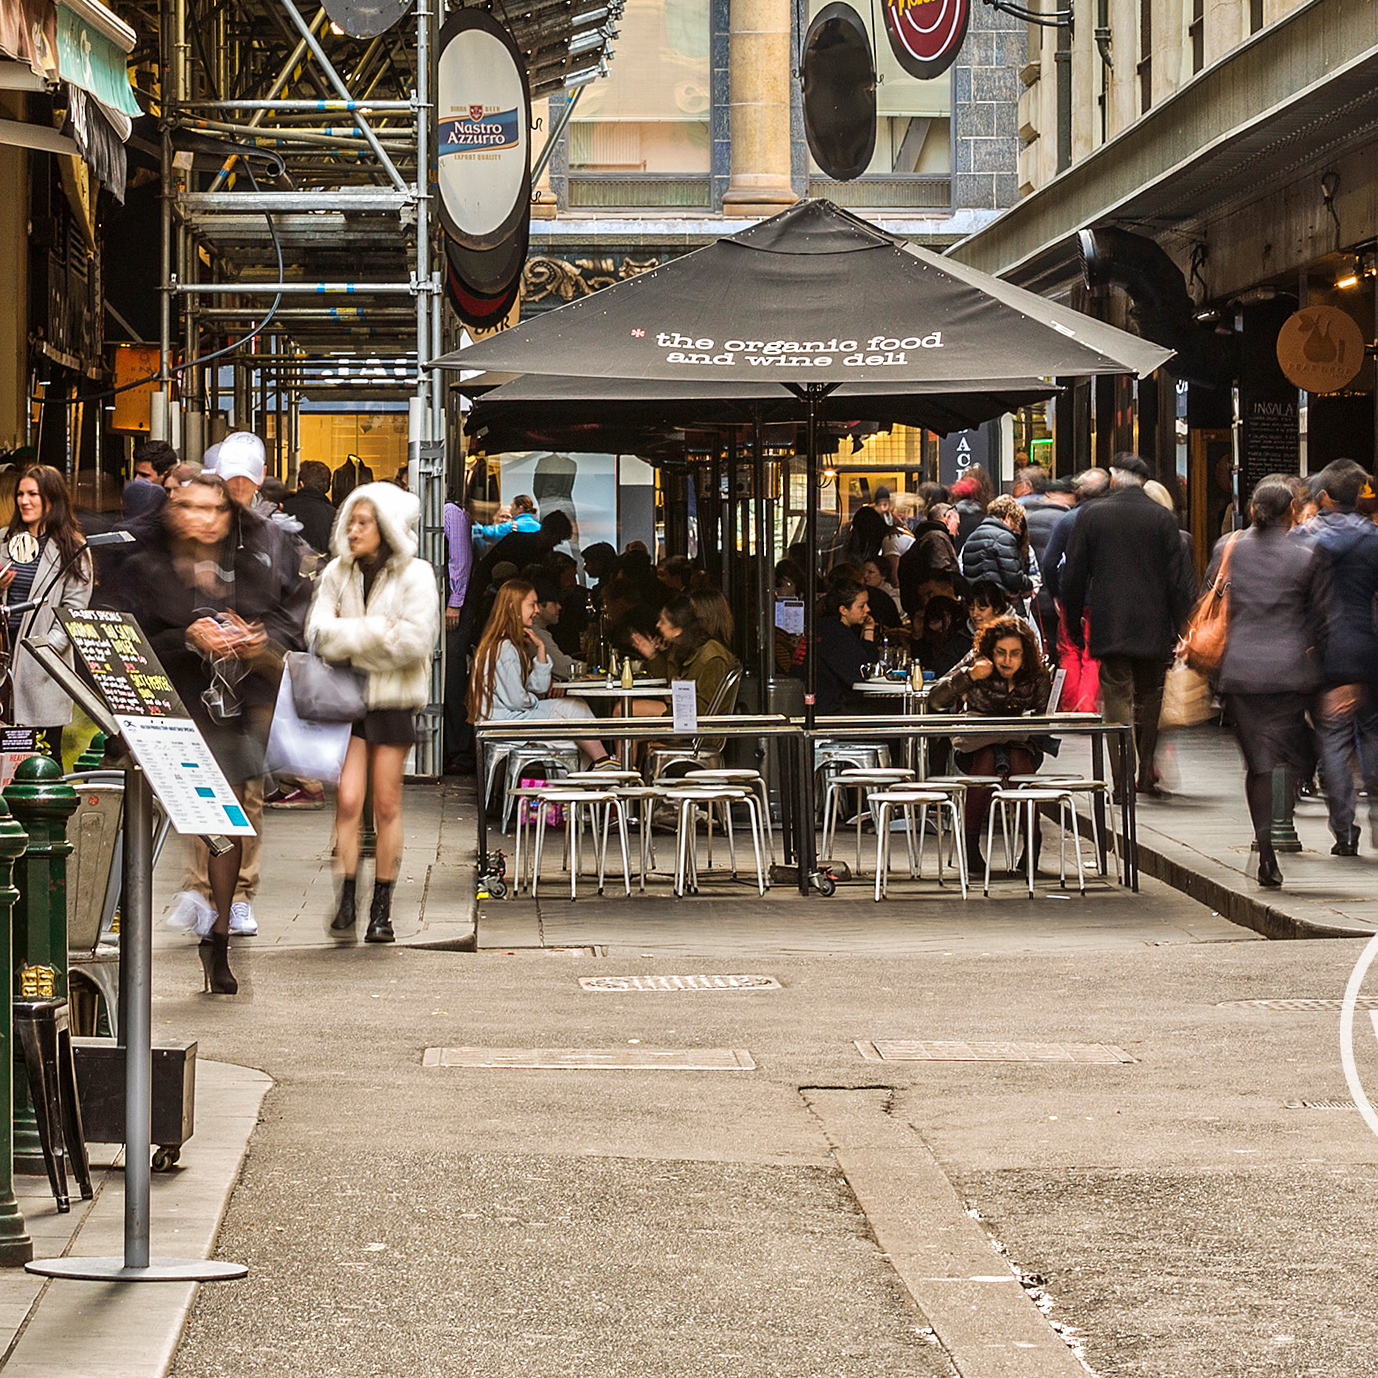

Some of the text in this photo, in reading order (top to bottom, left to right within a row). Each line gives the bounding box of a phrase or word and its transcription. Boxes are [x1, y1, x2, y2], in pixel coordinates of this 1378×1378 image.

[454, 121, 503, 134] Nastro
[447, 131, 506, 145] Azzurro
[656, 332, 944, 356] the organic food
[666, 353, 909, 368] and wine deli
[955, 428, 972, 482] AC
